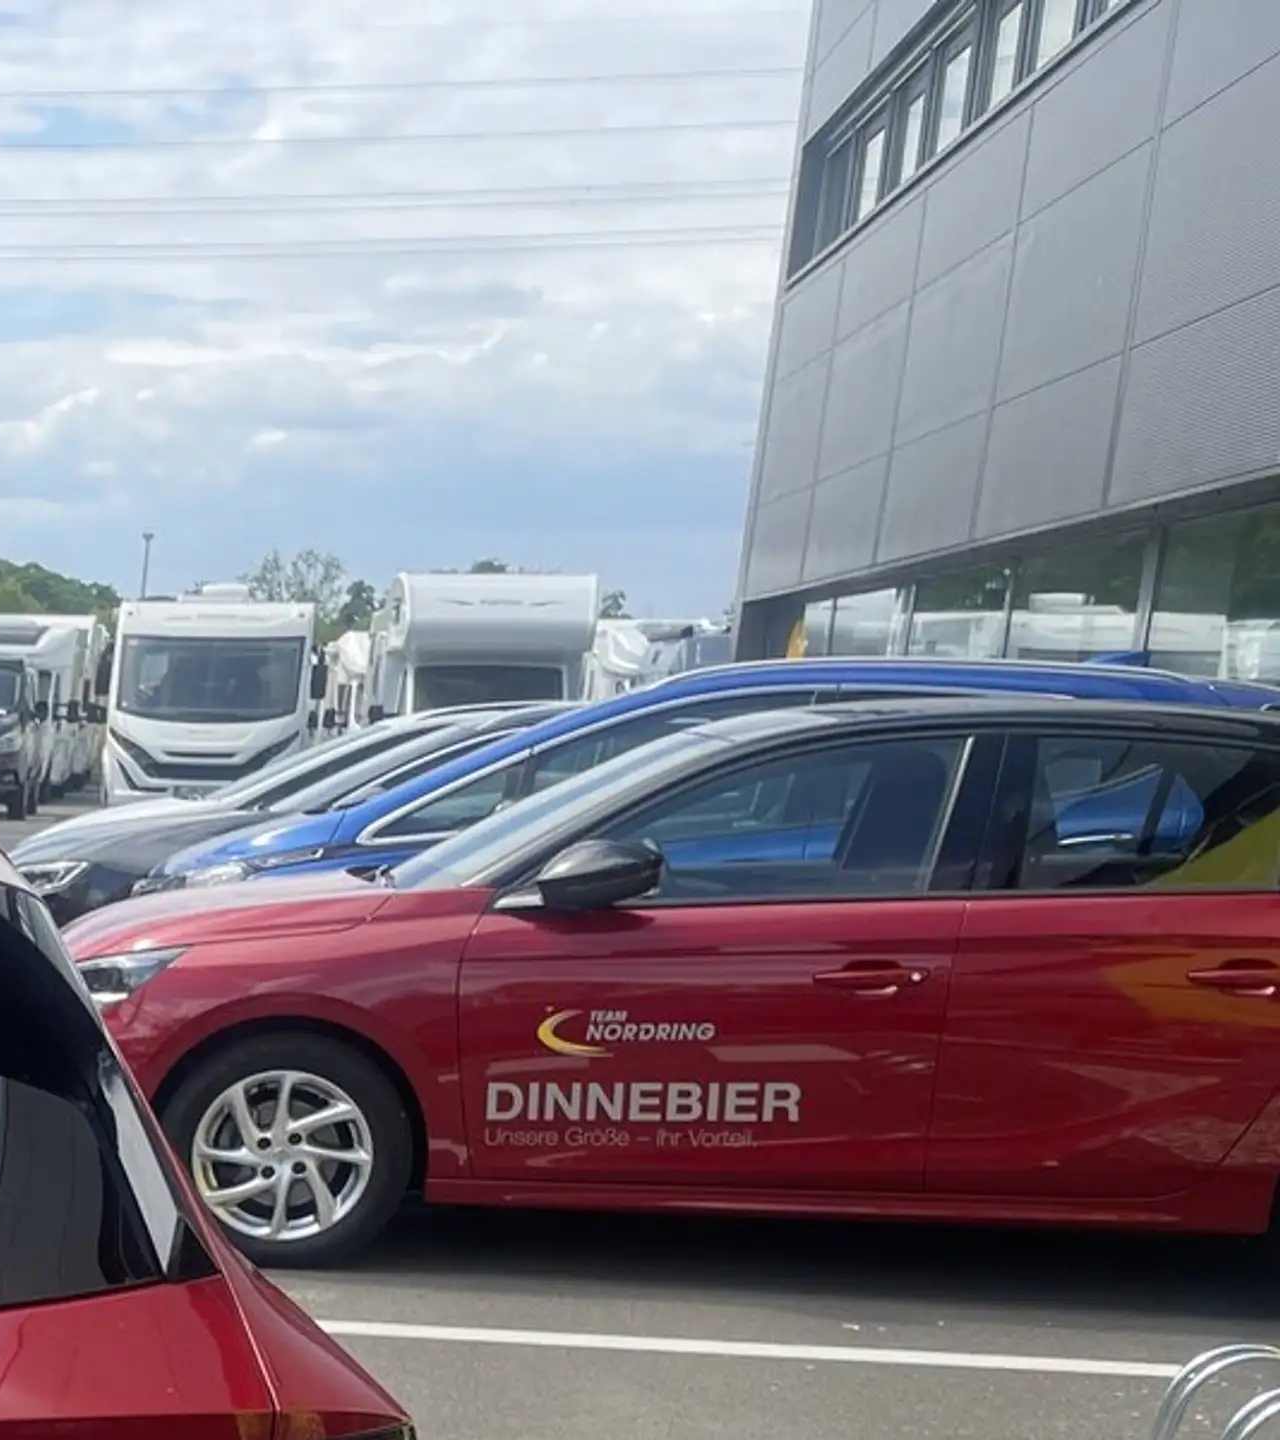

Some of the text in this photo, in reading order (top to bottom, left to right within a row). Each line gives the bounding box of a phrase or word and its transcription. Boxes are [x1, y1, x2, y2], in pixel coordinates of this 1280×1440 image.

[589, 1010, 628, 1022] TEAM
[586, 1023, 717, 1041] NORDRING
[485, 1082, 802, 1122] DINNEBIER
[485, 1128, 559, 1147] Unsere
[564, 1126, 630, 1147] Größe
[657, 1128, 680, 1147] Ihr
[688, 1128, 758, 1147] Vorteil.
